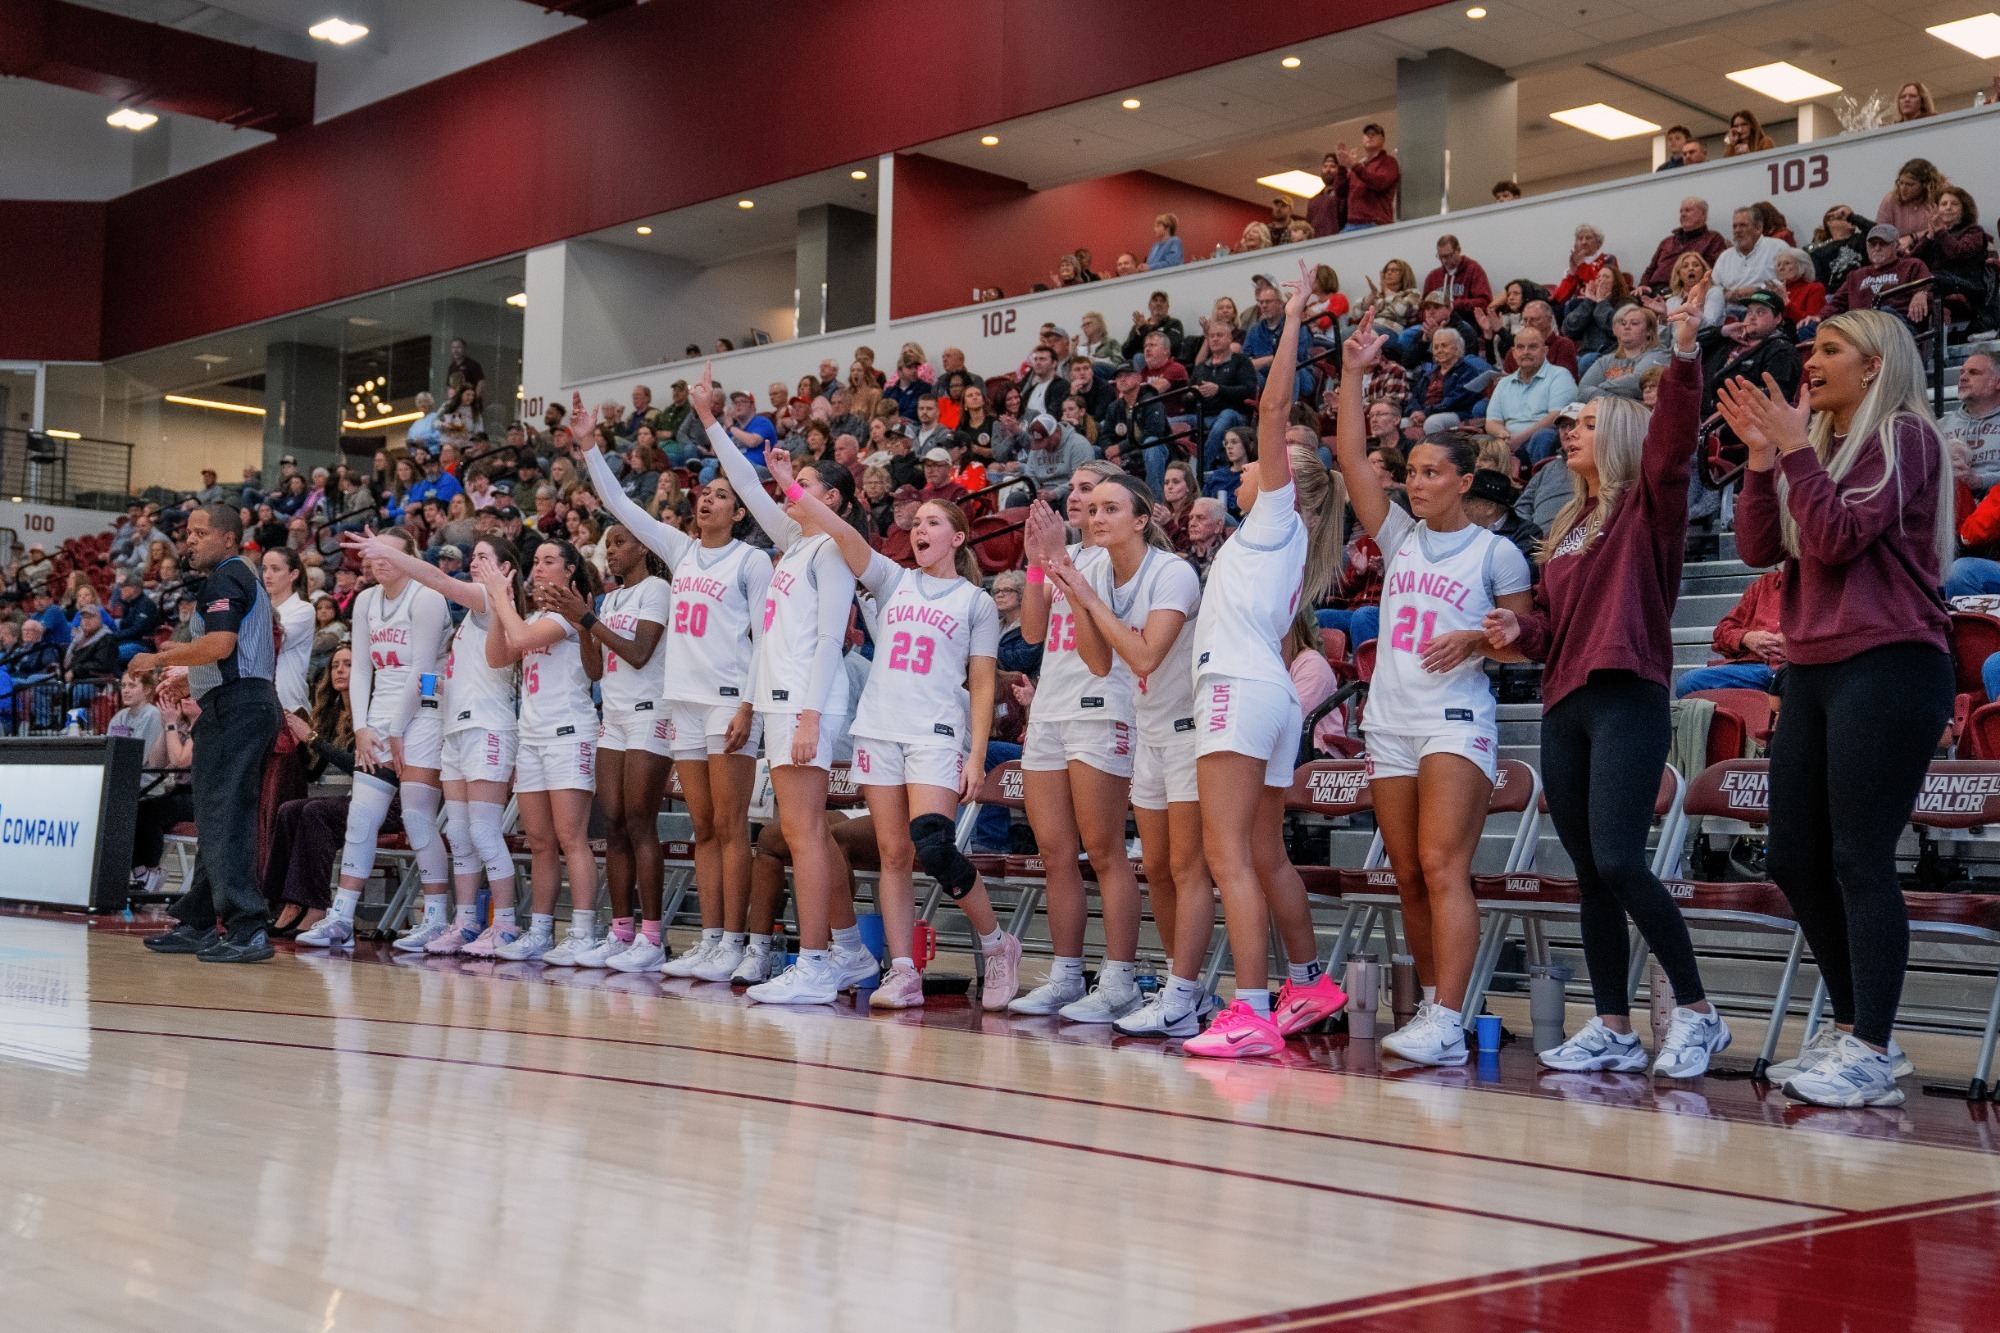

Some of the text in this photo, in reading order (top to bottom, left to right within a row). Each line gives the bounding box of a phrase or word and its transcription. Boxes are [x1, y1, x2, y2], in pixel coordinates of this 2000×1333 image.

[1767, 154, 1829, 195] 103
[982, 309, 1016, 338] 102
[524, 397, 543, 418] 101
[24, 513, 55, 532] 100
[672, 578, 728, 603] EVANGEL
[1389, 570, 1471, 612] EVANGEL
[675, 600, 708, 638] 20
[887, 605, 959, 640] EVANGEL
[1047, 613, 1077, 653] 33
[1391, 605, 1438, 654] 21
[889, 630, 936, 676] 23
[1209, 684, 1231, 733] VALOR
[487, 732, 501, 767] VALOR
[1114, 721, 1131, 757] VALO
[579, 741, 593, 775] VALOR
[1309, 772, 1368, 788] EVANGEL
[1315, 787, 1357, 802] VALOR
[1924, 776, 2000, 793] VANGEL
[1919, 793, 1984, 811] VALOR
[3, 818, 79, 848] COMPANY
[1368, 873, 1397, 884] VALOR
[1507, 879, 1538, 891] VALOR
